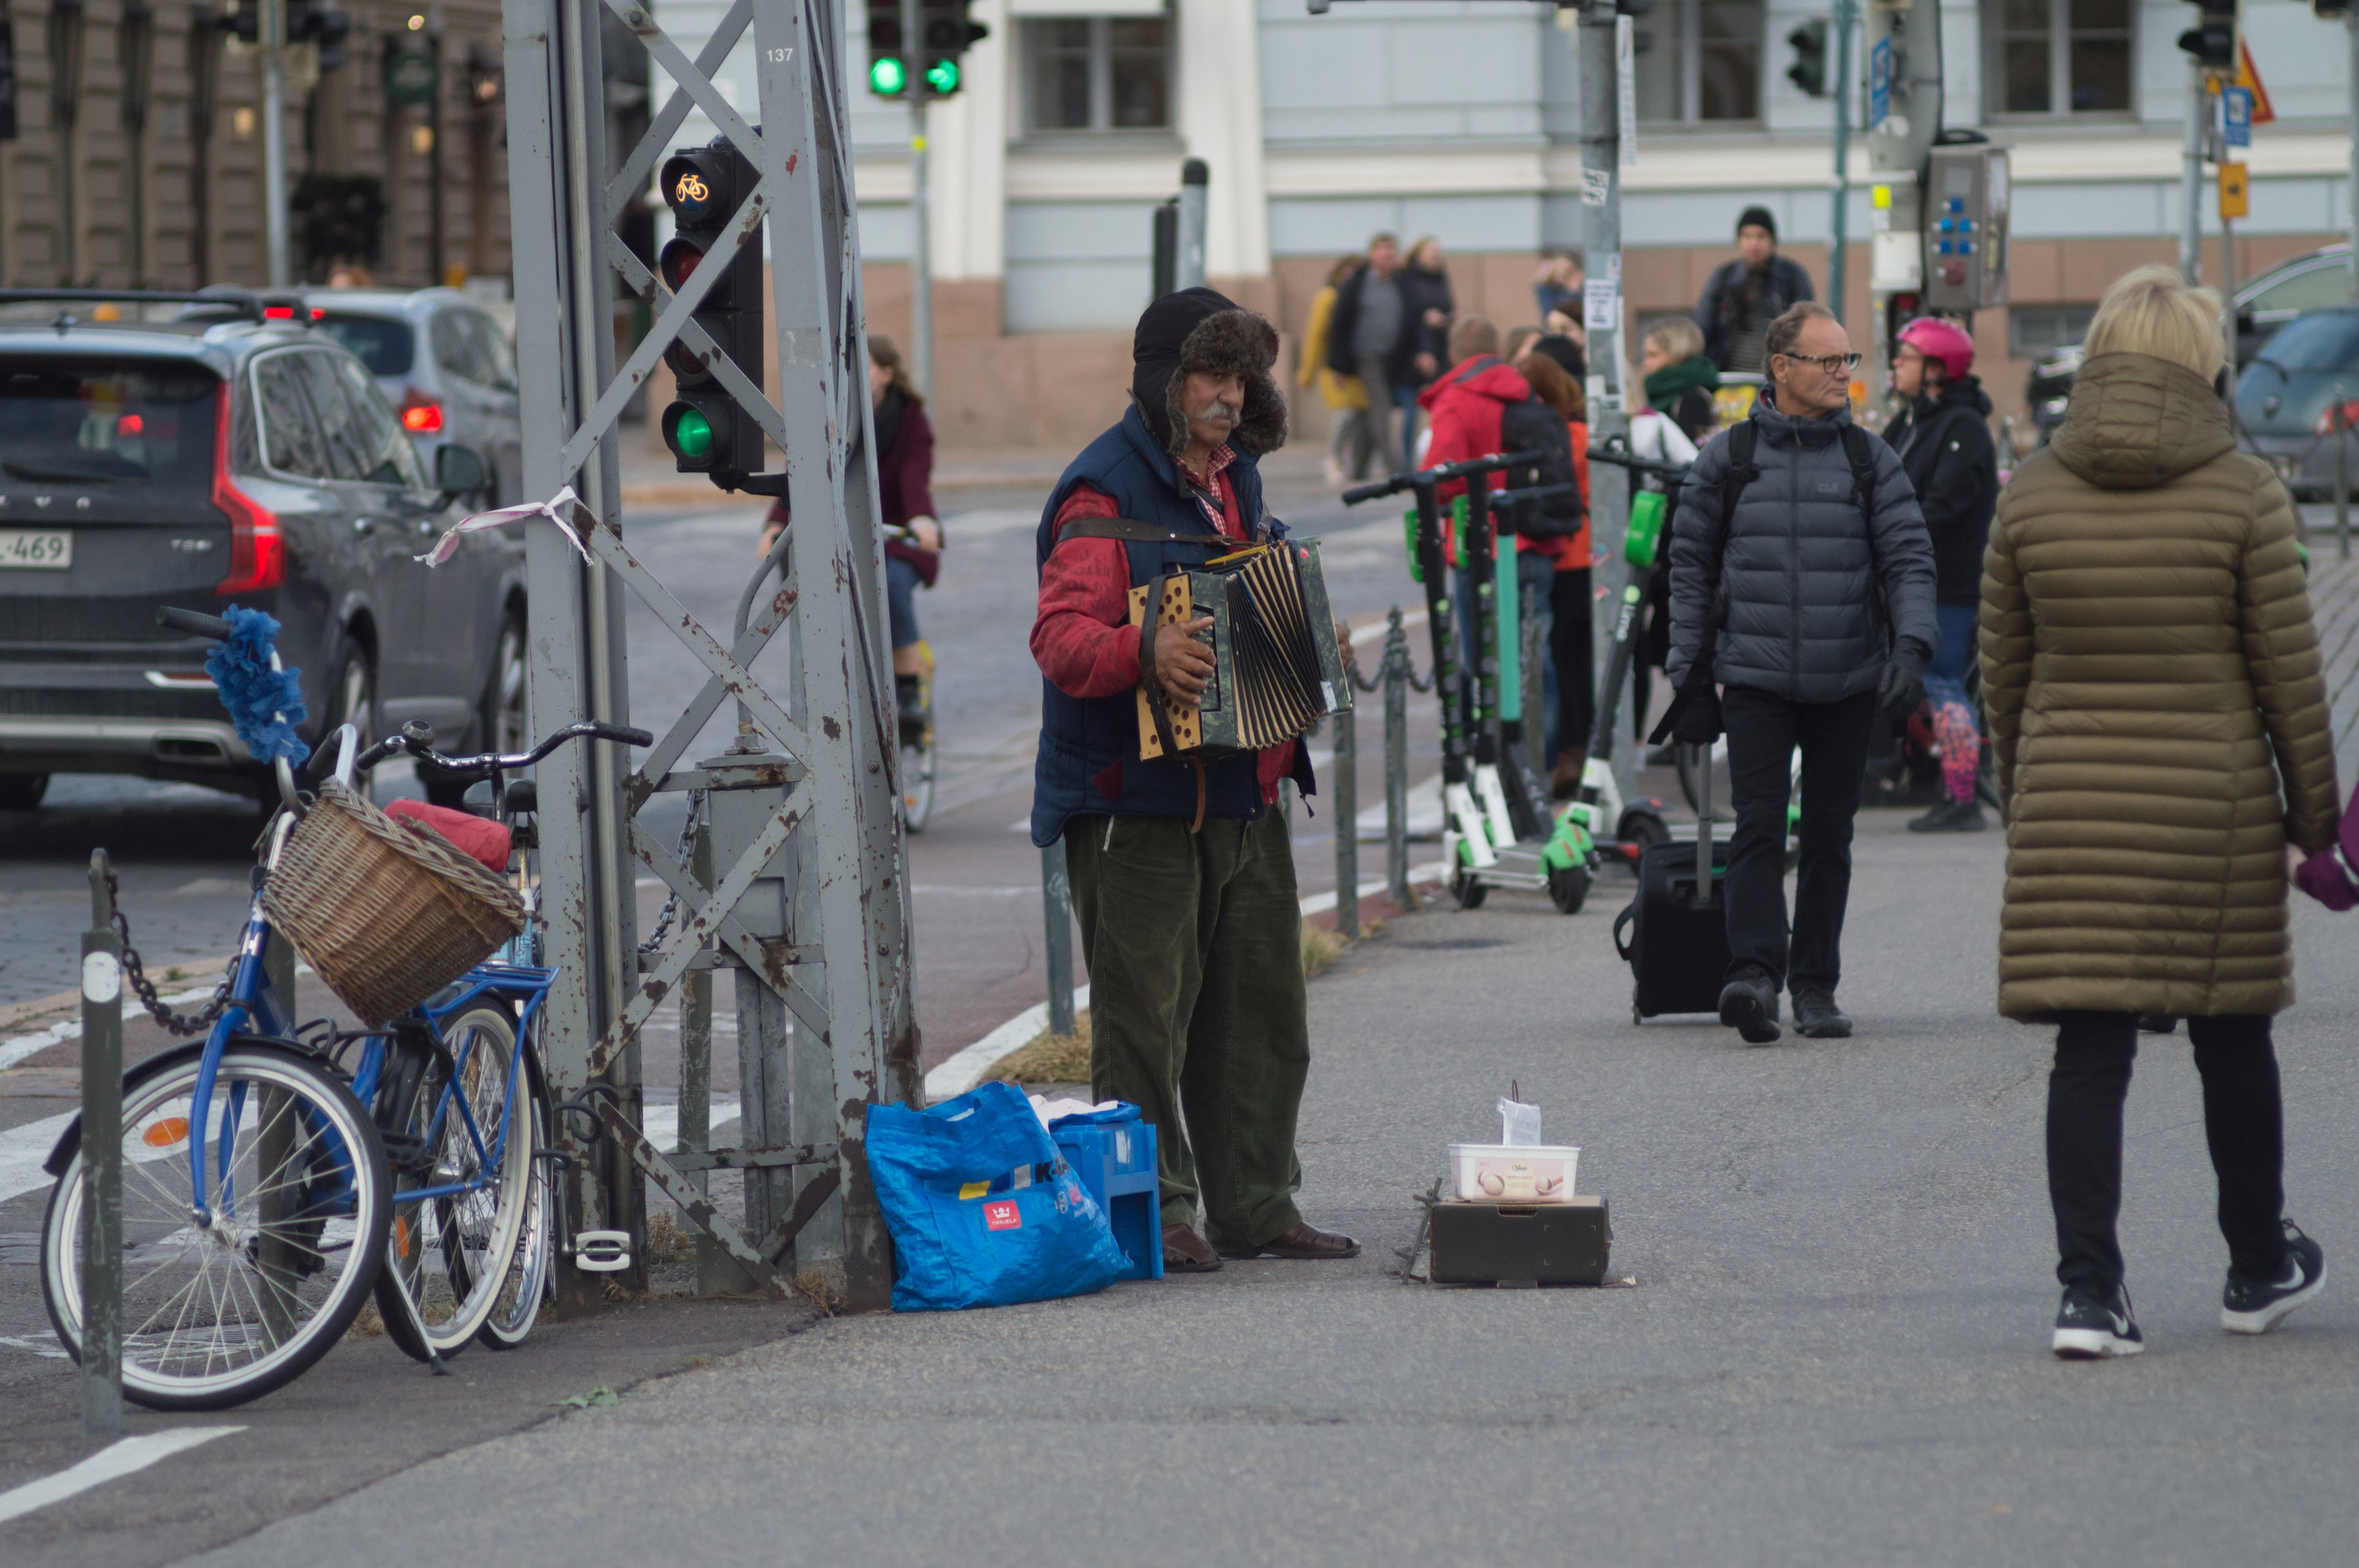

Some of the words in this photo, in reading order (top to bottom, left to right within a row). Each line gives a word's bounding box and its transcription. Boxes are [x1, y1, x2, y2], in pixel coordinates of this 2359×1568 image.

[767, 48, 793, 62] 137
[0, 536, 63, 560] -469
[1616, 604, 1636, 641] Lime
